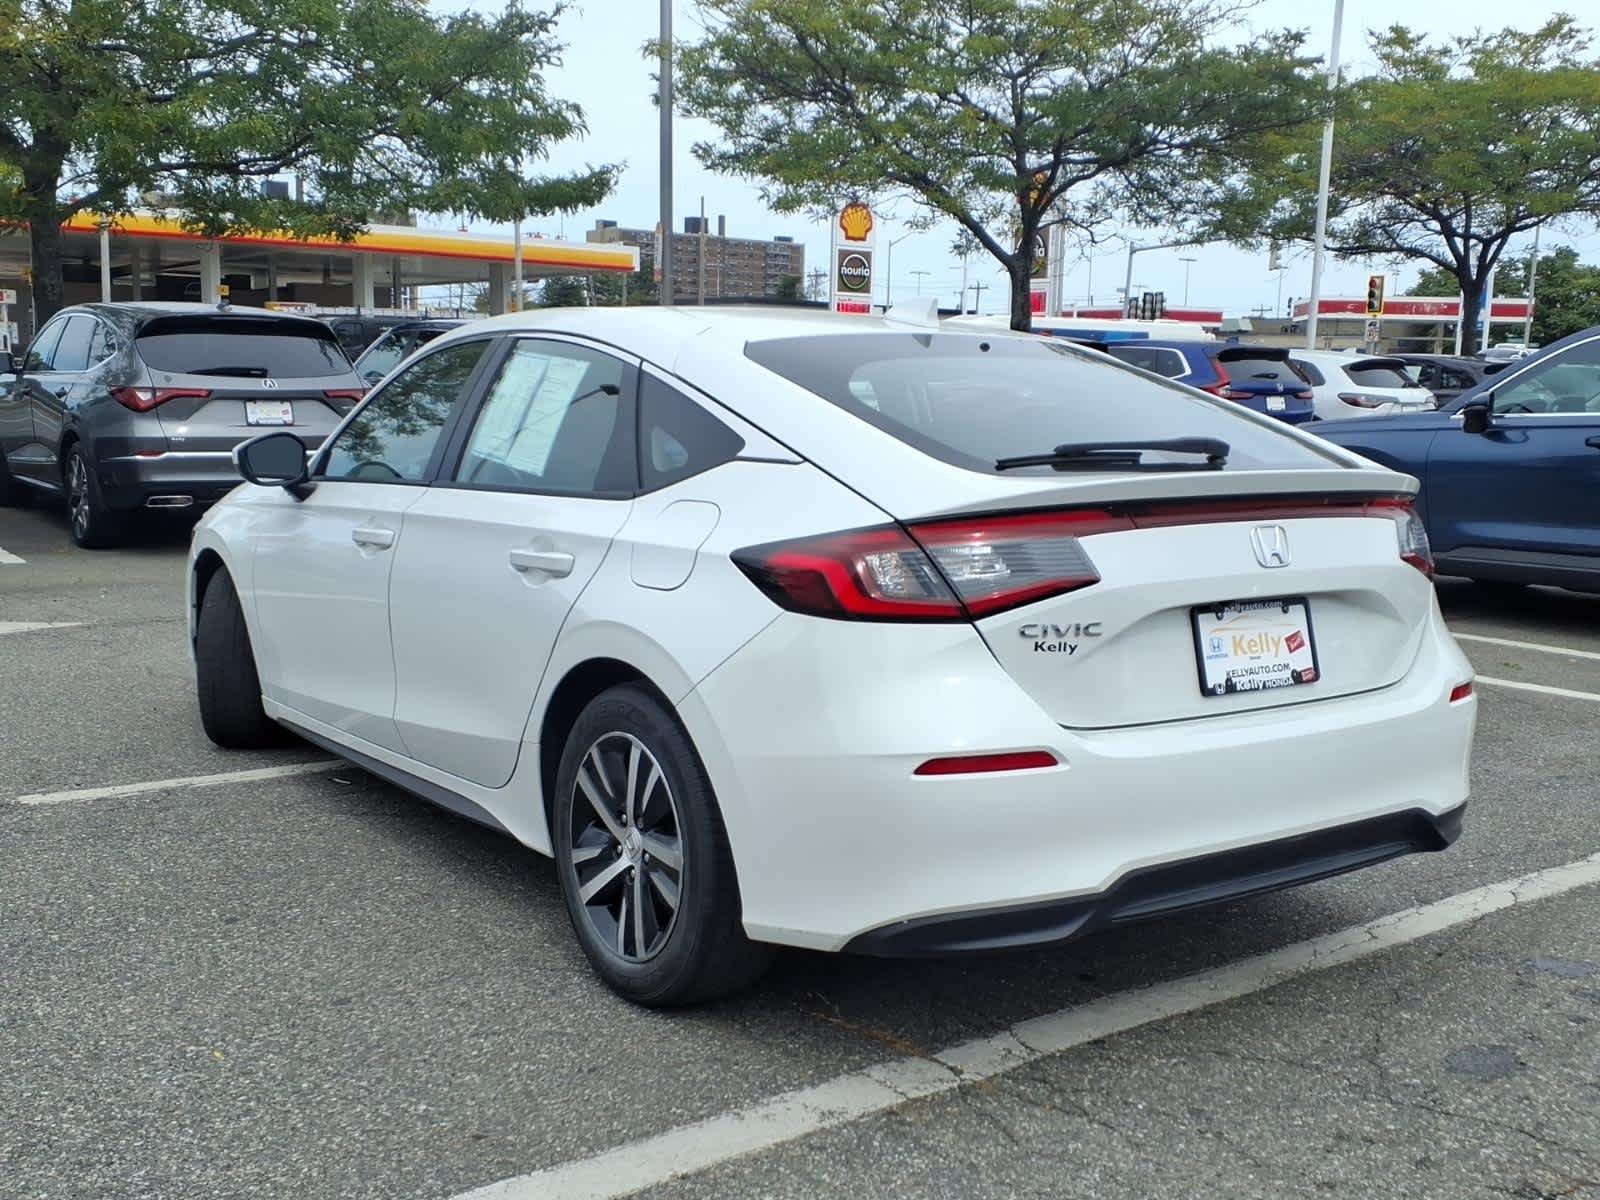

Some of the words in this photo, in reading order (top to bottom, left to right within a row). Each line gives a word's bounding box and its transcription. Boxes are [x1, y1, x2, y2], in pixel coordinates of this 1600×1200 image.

[841, 265, 870, 277] nouria
[1019, 622, 1103, 639] CIVIC
[1033, 641, 1078, 655] Kelly
[1232, 632, 1281, 657] Kelly
[1225, 663, 1291, 678] KELLYAUTO.COM
[1236, 678, 1264, 691] Kelly
[1265, 677, 1295, 688] HONDA
